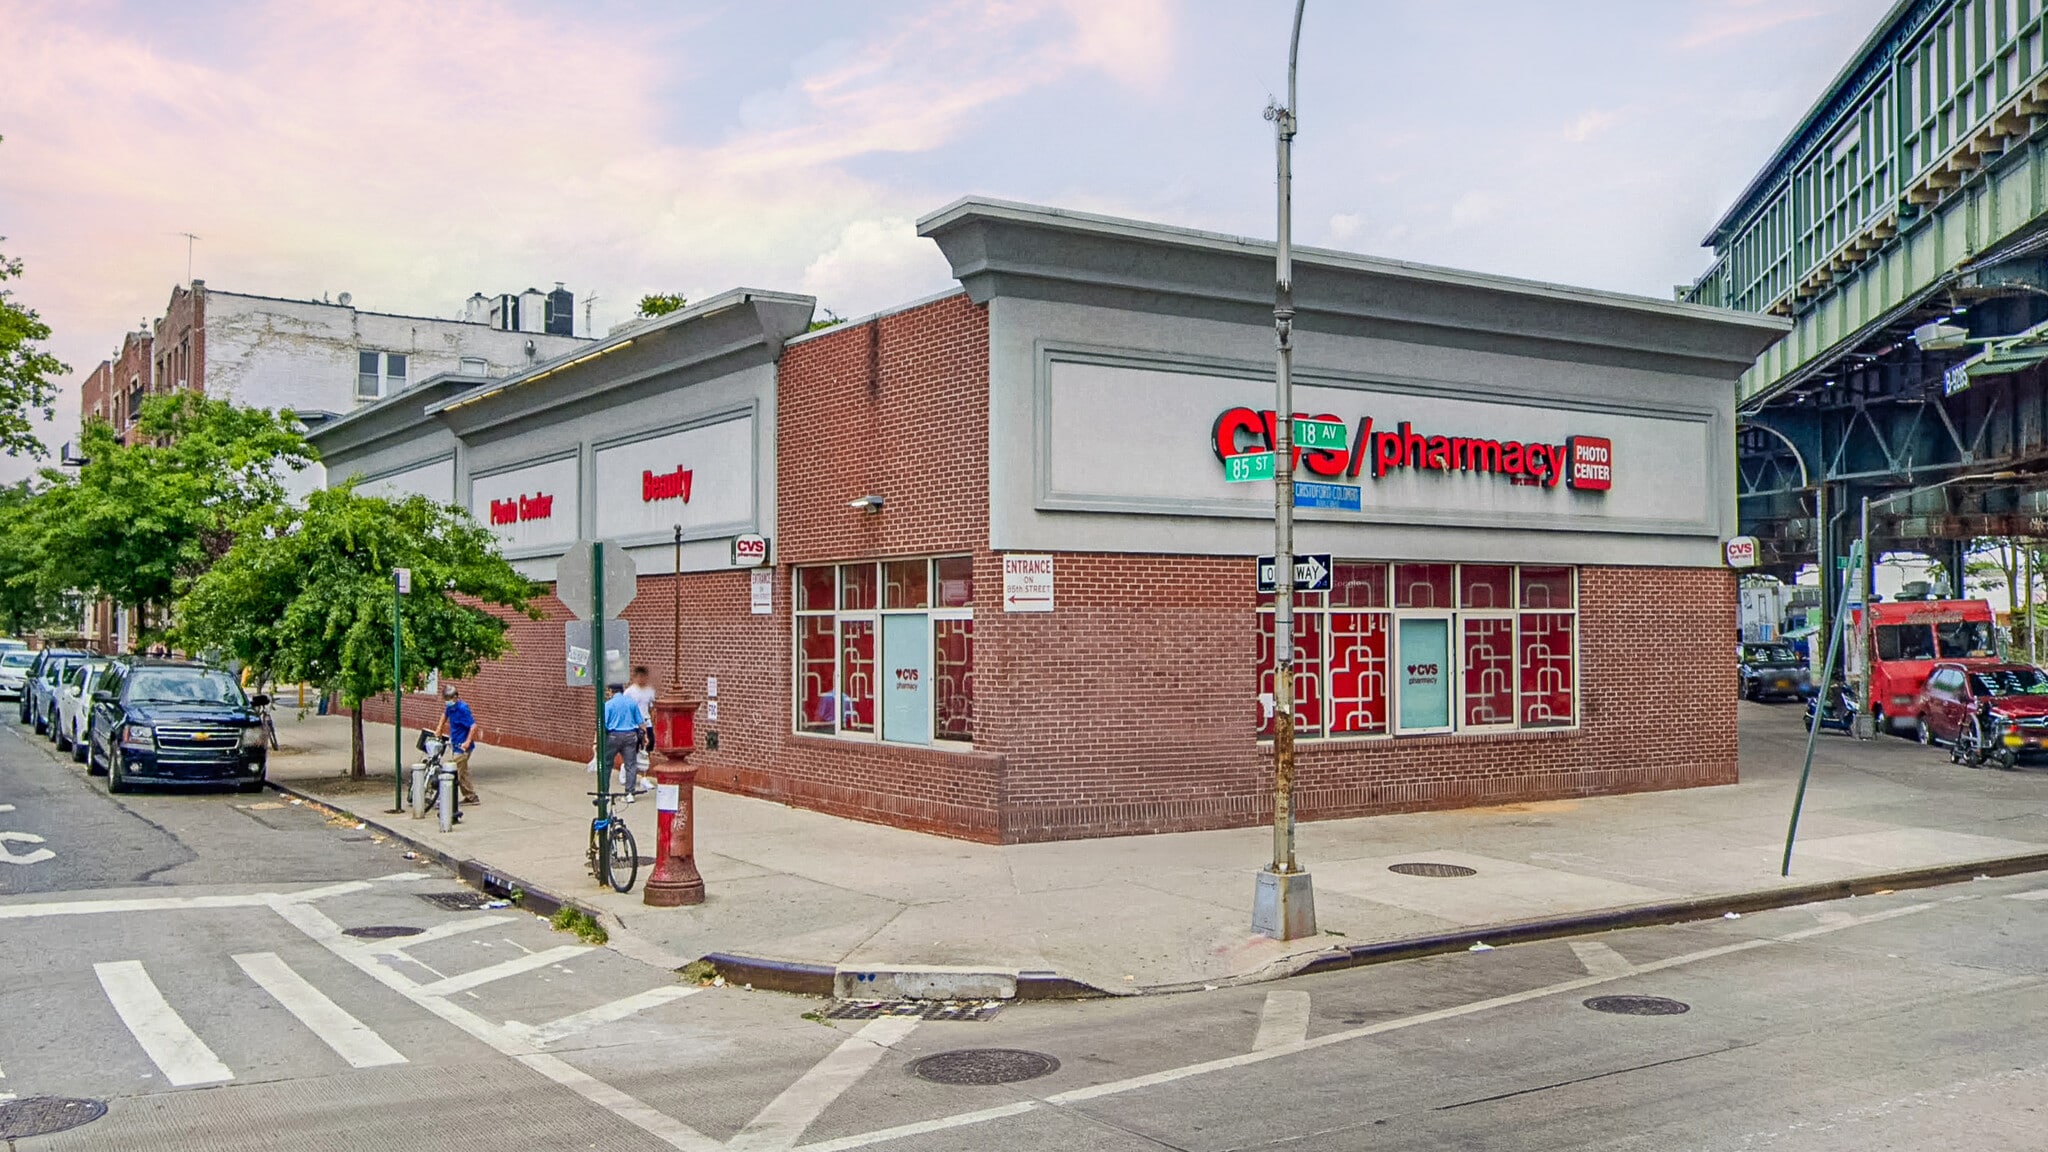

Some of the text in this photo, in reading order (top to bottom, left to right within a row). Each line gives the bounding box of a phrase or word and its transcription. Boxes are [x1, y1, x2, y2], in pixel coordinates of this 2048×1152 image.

[1302, 424, 1337, 444] 18 AV
[1576, 445, 1608, 462] PHOTO
[1233, 456, 1269, 480] 85 ST
[1574, 465, 1610, 481] CENTER
[642, 464, 693, 504] Beauty
[490, 491, 554, 526] Photo Center
[737, 540, 764, 552] CVS
[1729, 543, 1753, 554] CVS
[1006, 560, 1051, 574] ENTRANCE
[1296, 565, 1320, 580] WAY
[1023, 575, 1034, 584] ON
[1025, 584, 1051, 593] STREET
[902, 668, 919, 681] CVS
[1417, 664, 1438, 675] CVS
